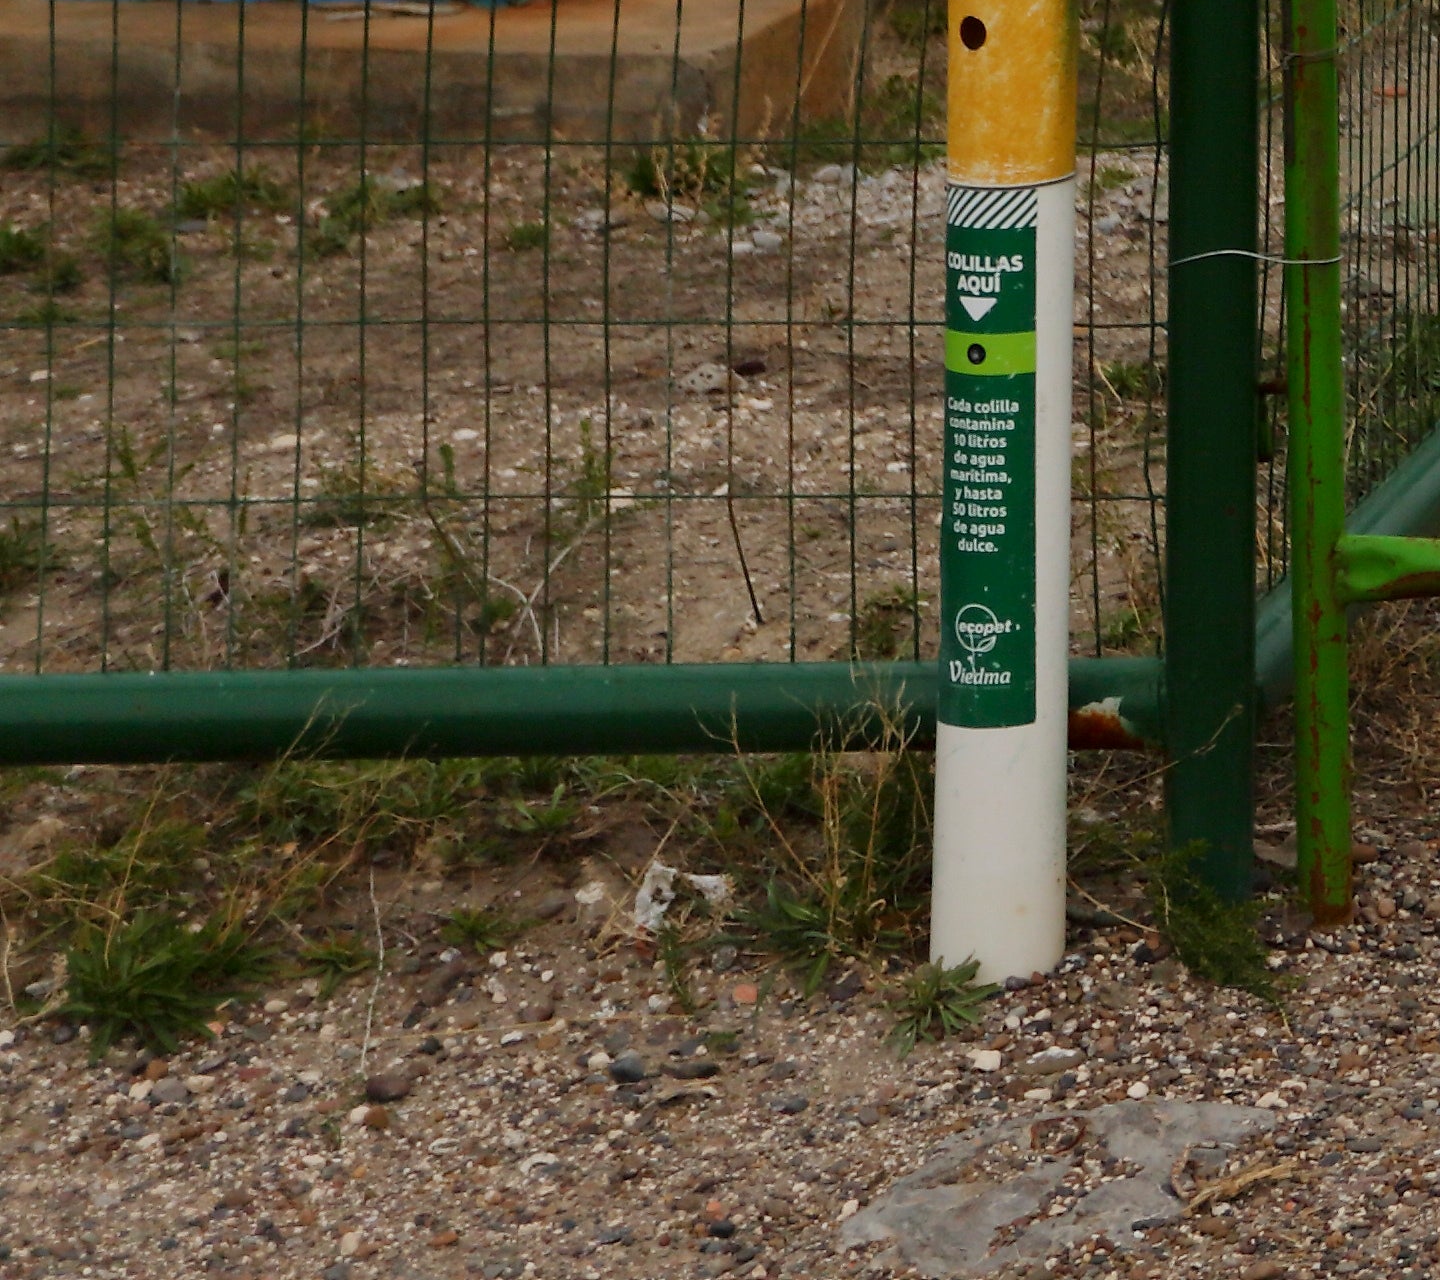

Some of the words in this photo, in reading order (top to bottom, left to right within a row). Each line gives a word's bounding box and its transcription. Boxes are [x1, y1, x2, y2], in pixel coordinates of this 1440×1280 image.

[948, 251, 1024, 272] COLILLAS
[957, 272, 1001, 295] AQUÍ
[947, 397, 971, 413] Cada
[974, 398, 1020, 414] colilla
[949, 417, 1015, 431] contamina
[954, 433, 967, 447] 10
[968, 433, 1007, 448] litros
[953, 450, 968, 464] de
[970, 454, 1005, 468] agua
[954, 487, 962, 500] y
[964, 486, 1003, 500] hasta
[952, 502, 966, 516] 50
[968, 503, 1007, 517] litros
[953, 520, 968, 534] de
[970, 524, 1005, 537] agua
[957, 538, 998, 552] dulce.
[949, 659, 1011, 685] Viedma
